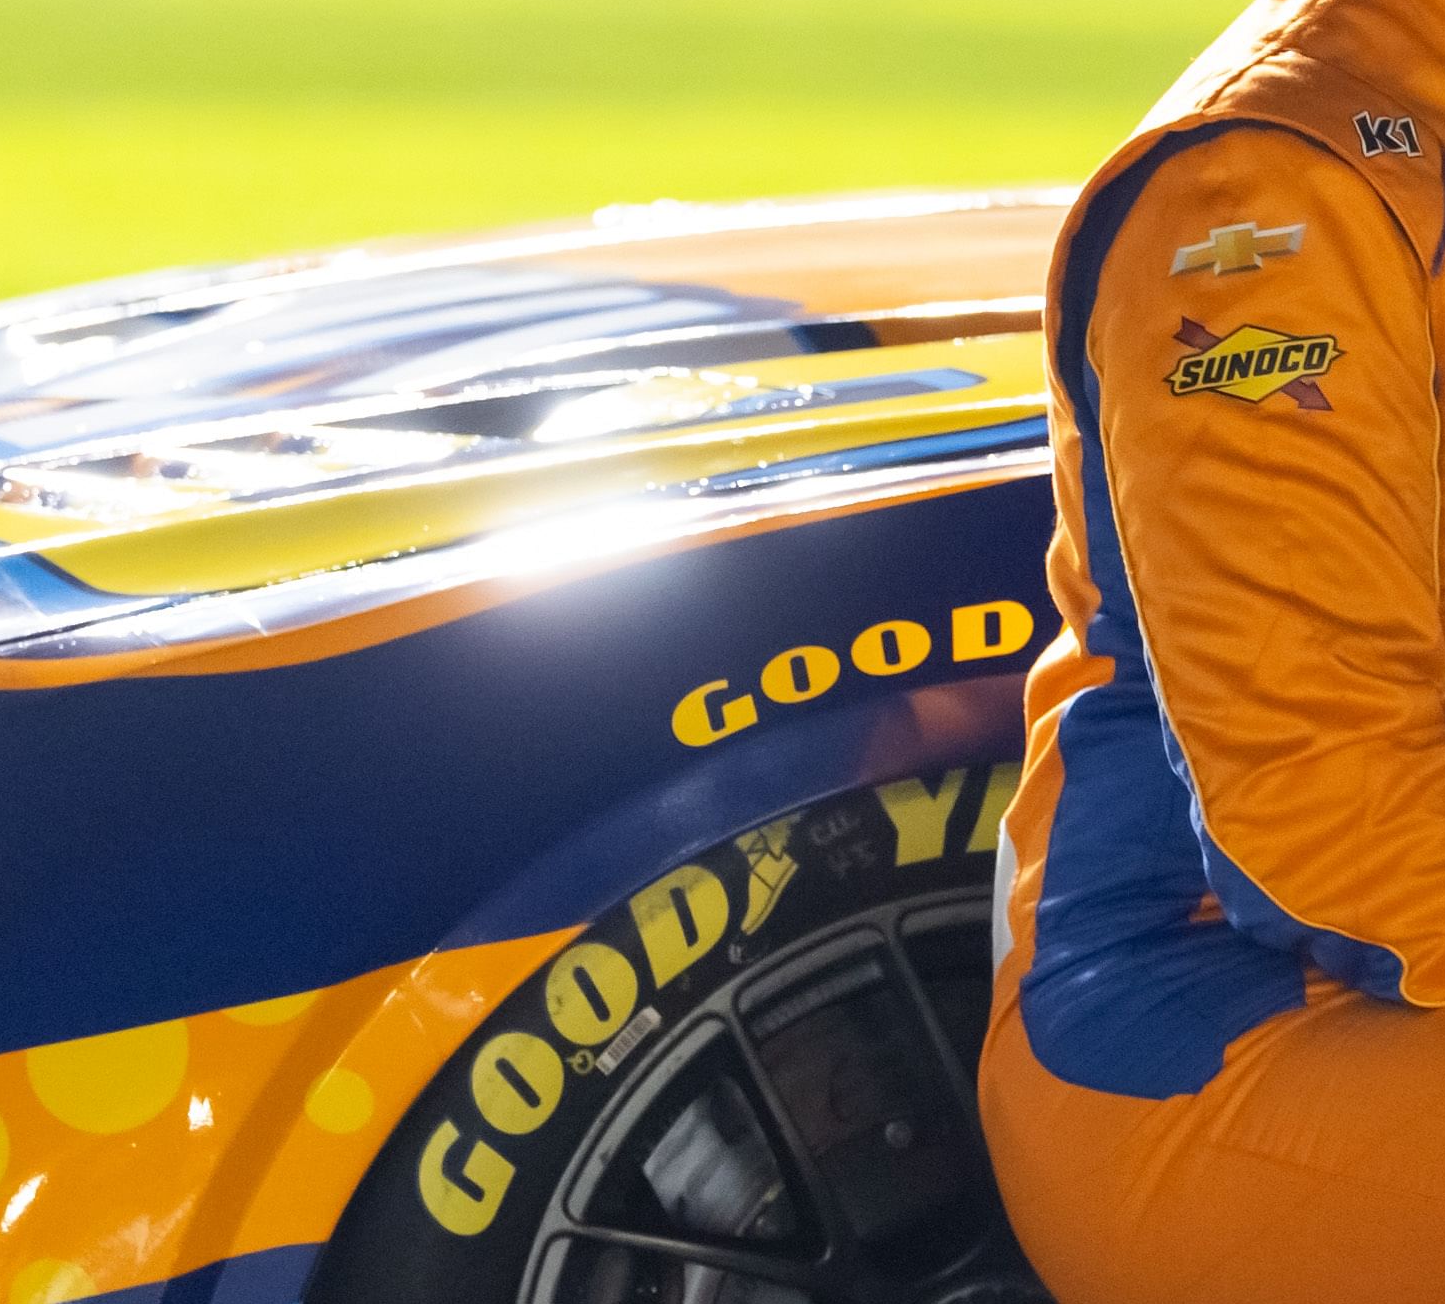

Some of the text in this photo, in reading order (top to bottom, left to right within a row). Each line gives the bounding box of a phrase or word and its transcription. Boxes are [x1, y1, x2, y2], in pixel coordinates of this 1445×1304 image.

[1353, 110, 1423, 157] K1
[1177, 341, 1330, 390] SUNOCO
[671, 599, 1034, 747] GOOD
